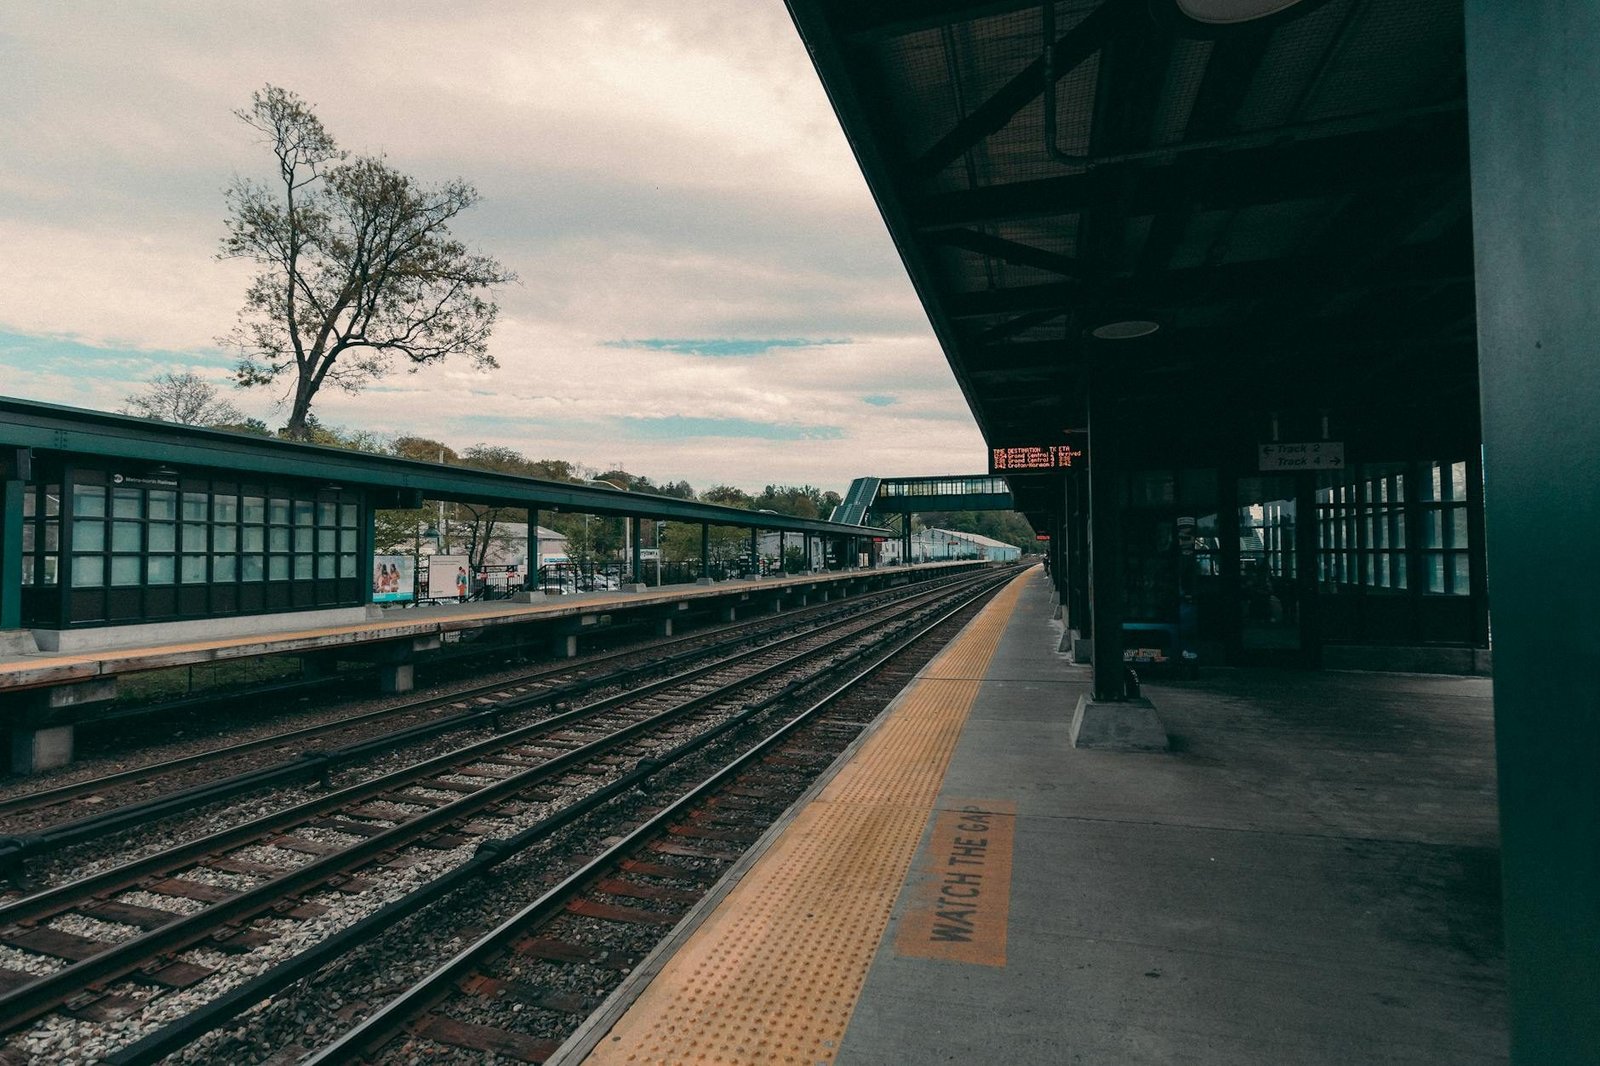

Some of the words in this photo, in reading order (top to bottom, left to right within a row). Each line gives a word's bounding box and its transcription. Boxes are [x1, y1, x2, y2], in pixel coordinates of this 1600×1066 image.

[1278, 444, 1306, 454] Track
[1313, 443, 1320, 452] 2
[1278, 456, 1307, 466] Track
[958, 805, 993, 832] GAP
[948, 837, 988, 866] THE
[930, 872, 982, 942] WATCH
